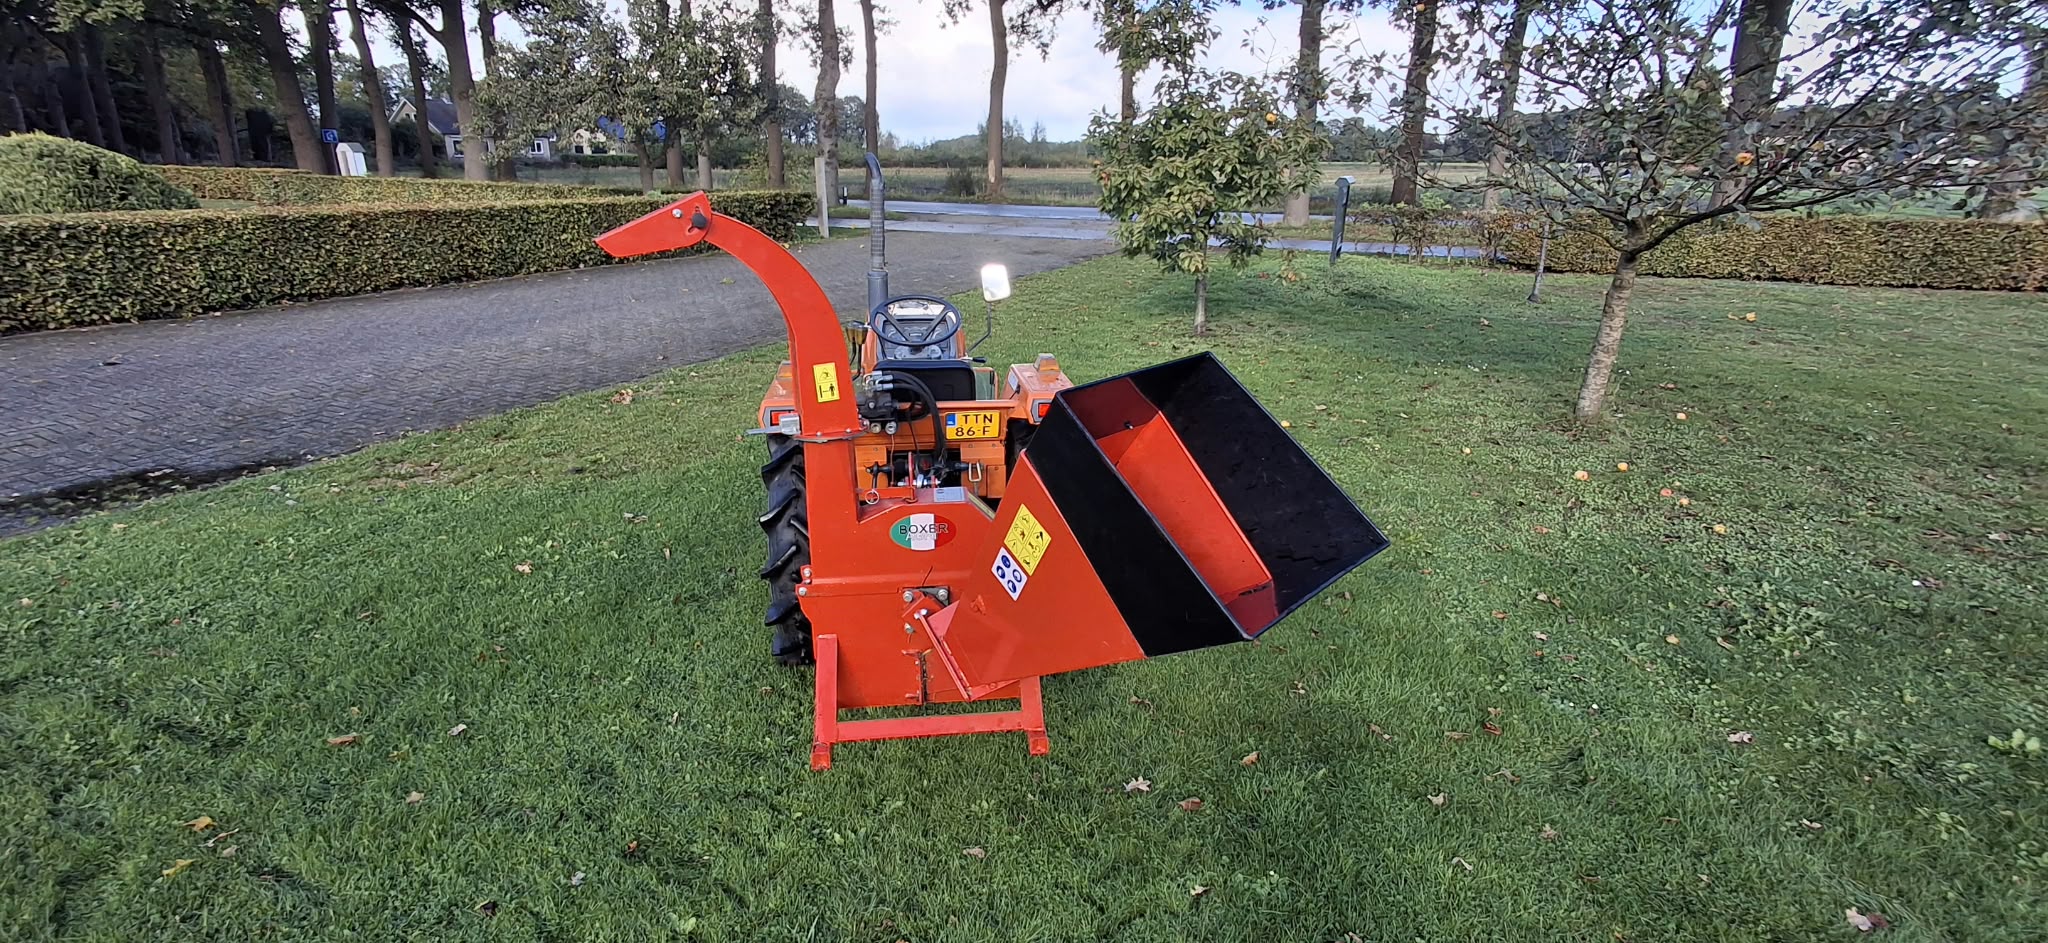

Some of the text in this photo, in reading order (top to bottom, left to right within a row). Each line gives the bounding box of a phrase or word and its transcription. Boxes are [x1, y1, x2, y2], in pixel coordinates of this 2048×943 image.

[961, 413, 993, 424] TTN
[955, 425, 991, 437] 86-F
[899, 523, 948, 535] BOXER
